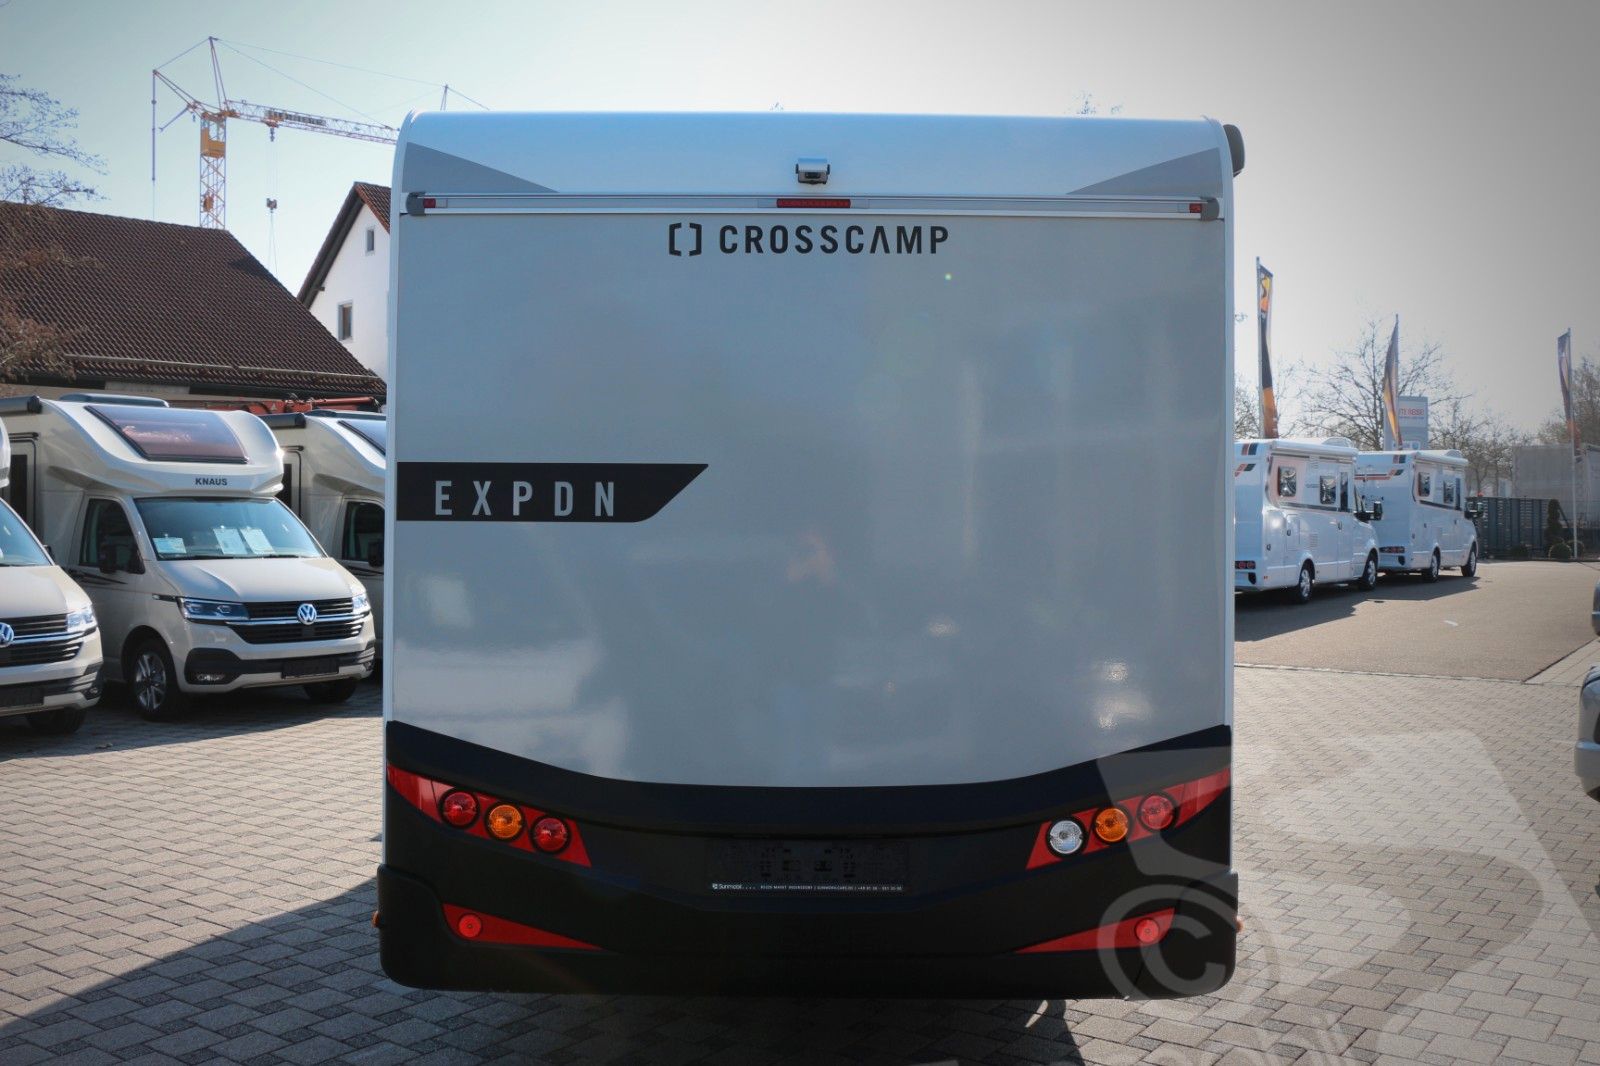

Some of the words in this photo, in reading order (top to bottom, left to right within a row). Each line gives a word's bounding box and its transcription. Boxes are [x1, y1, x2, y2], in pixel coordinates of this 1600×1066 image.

[719, 225, 949, 254] CROSSCAMP
[194, 477, 229, 486] KNAUS
[434, 480, 615, 517] EXPDN
